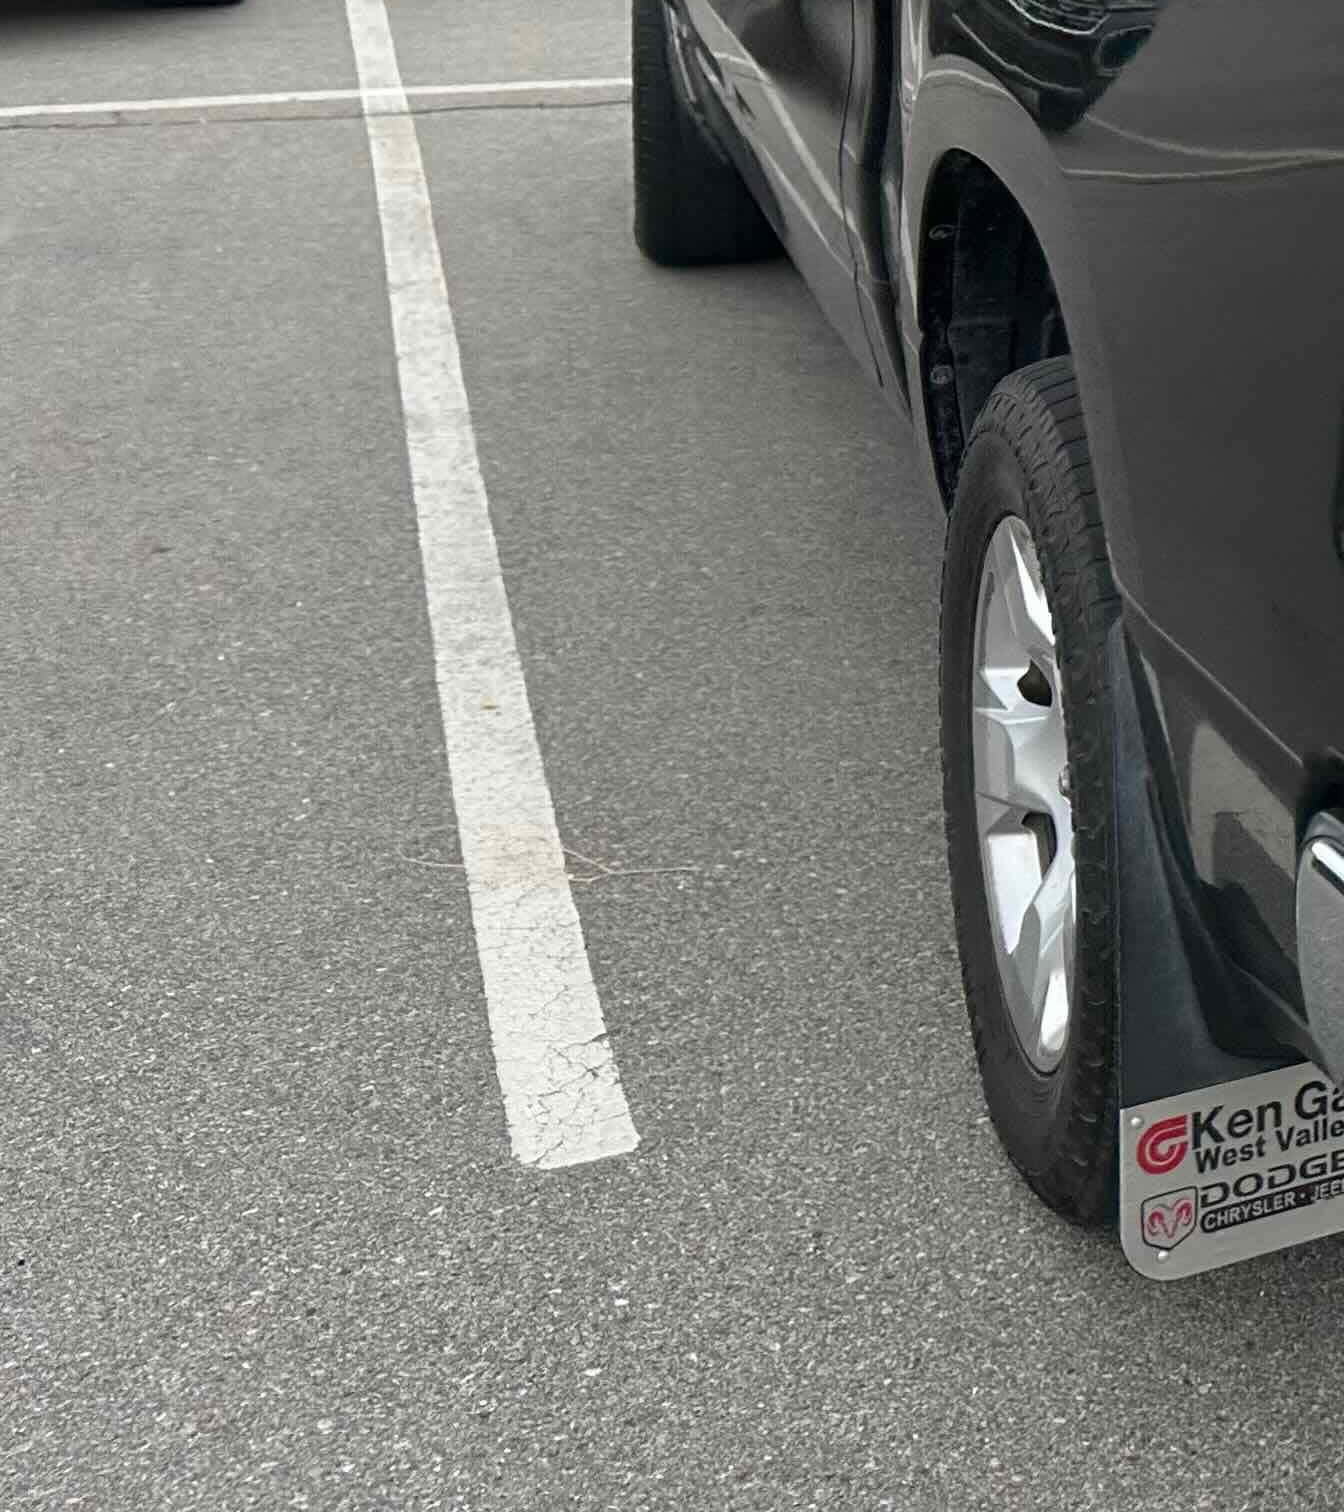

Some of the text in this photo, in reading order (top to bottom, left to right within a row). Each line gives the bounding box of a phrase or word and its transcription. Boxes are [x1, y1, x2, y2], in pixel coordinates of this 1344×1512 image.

[1192, 1101, 1282, 1149] Ken
[1195, 1136, 1266, 1174] West
[1203, 1191, 1297, 1232] CHRYSLER
